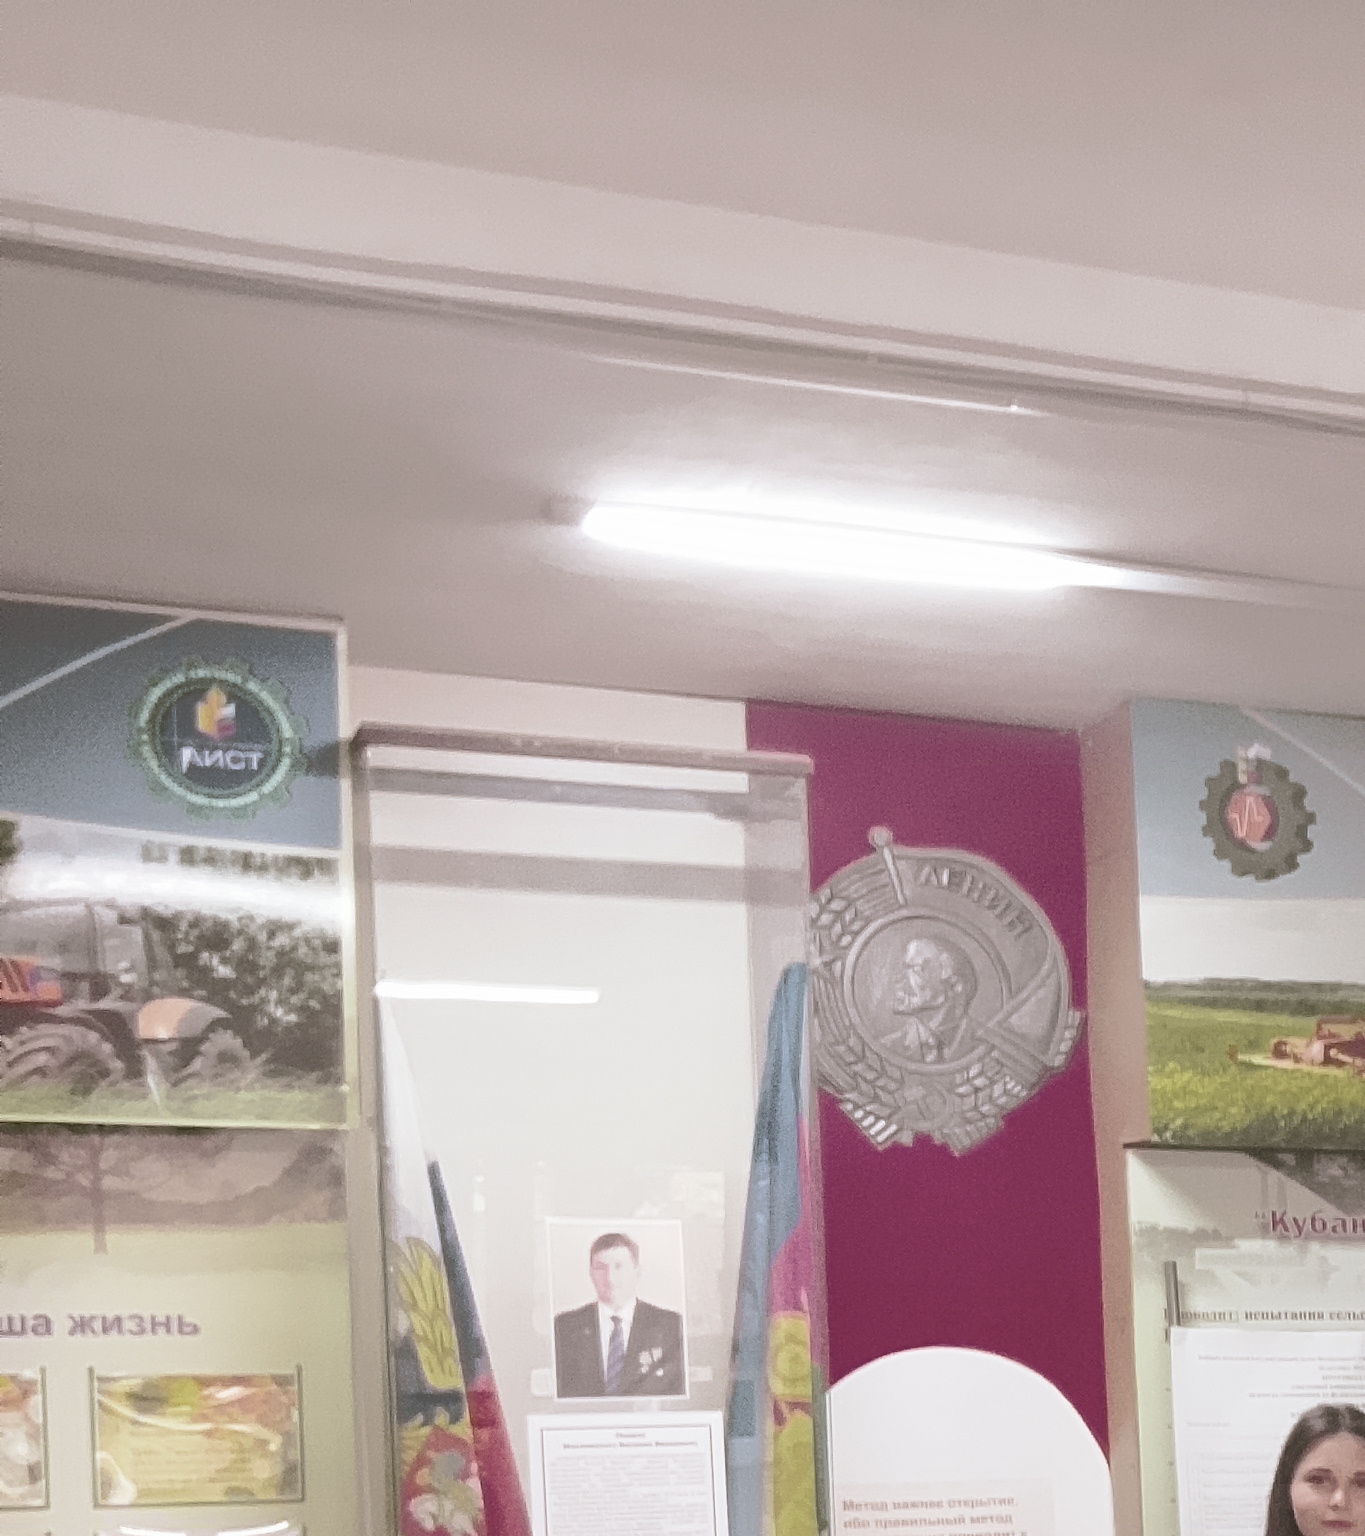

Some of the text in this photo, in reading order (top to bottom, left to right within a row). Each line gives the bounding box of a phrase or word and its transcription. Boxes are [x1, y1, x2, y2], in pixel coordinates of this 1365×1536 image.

[919, 864, 1034, 940] ЛЕНИН
[1244, 1310, 1325, 1321] испытания
[66, 1312, 200, 1337] жизнь
[842, 1499, 889, 1512] Метод
[875, 1514, 966, 1529] правильный
[970, 1512, 1013, 1525] метод
